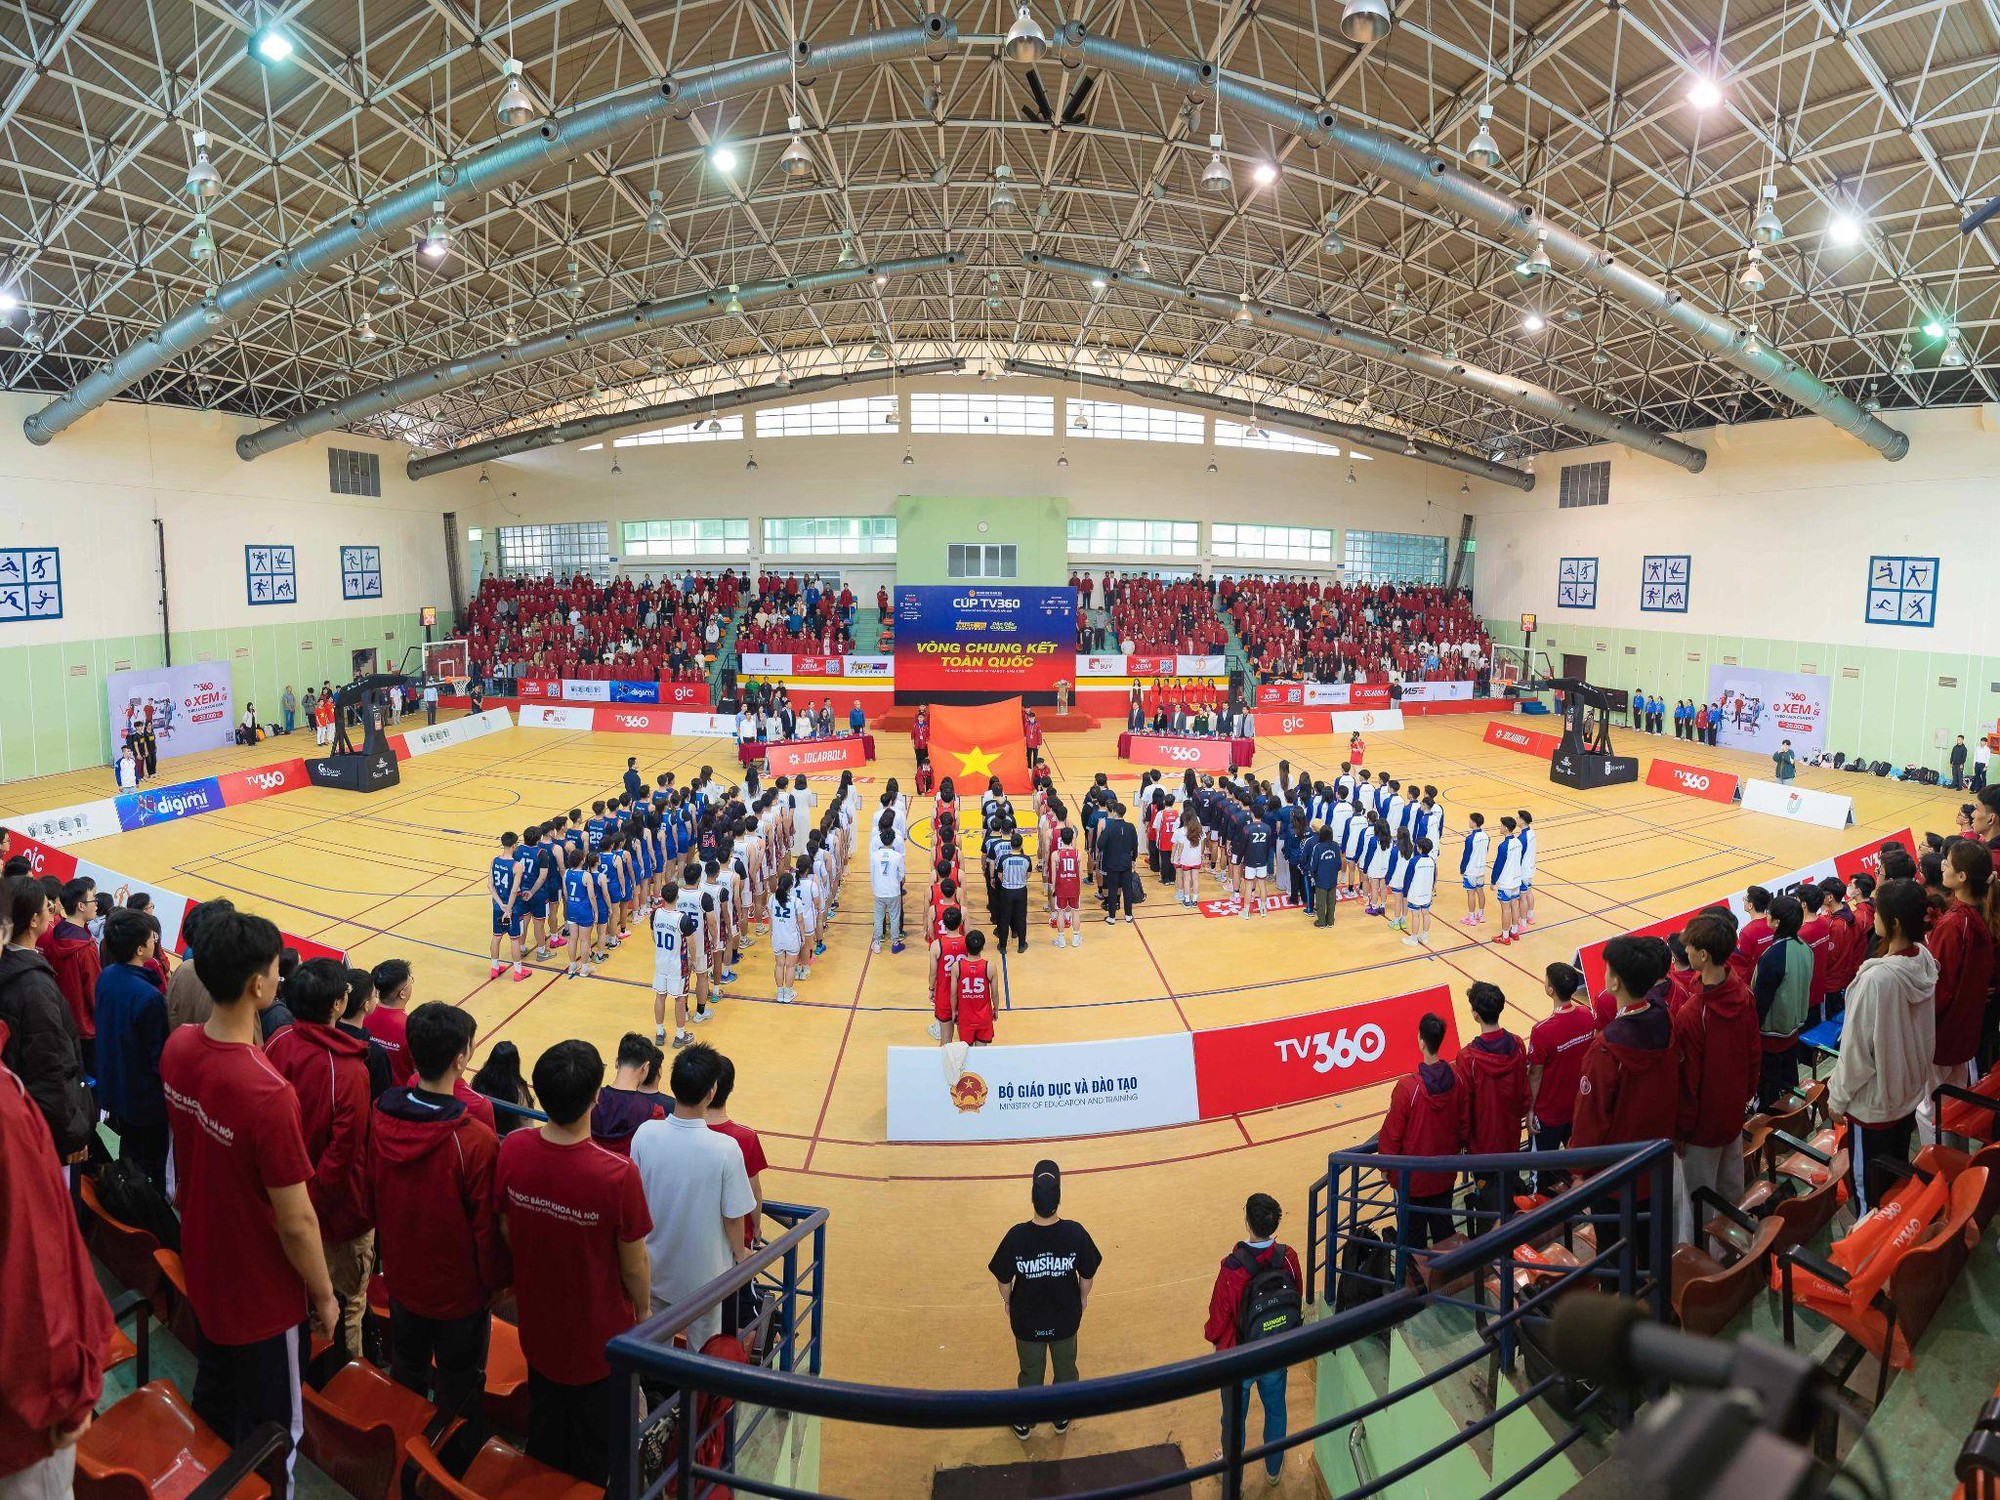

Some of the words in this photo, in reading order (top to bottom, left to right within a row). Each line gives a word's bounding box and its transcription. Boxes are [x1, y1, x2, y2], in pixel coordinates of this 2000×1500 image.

[953, 597, 978, 608] CÚP
[980, 599, 1020, 608] TV360
[917, 641, 960, 653] VÒNG
[965, 643, 1022, 654] CHUNG
[1026, 641, 1058, 654] KẾT
[941, 655, 984, 667] TOÀN
[988, 655, 1034, 668] QUỐC
[193, 691, 220, 706] XEM
[674, 686, 694, 700] gic
[1785, 691, 1806, 701] TV360
[1782, 703, 1811, 715] XEM
[616, 714, 649, 728] TV360
[1283, 716, 1304, 733] gic
[802, 749, 847, 764] JOGARBOLA
[1159, 745, 1201, 761] TV360
[246, 770, 285, 789] TV360
[1673, 769, 1710, 791] TV360
[157, 788, 208, 816] digimi
[702, 834, 717, 848] 54
[1252, 833, 1267, 843] 22
[881, 861, 890, 875] 7
[1062, 858, 1075, 871] 10
[1861, 849, 1884, 876] TV3
[493, 871, 509, 888] 34
[570, 882, 577, 896] 7
[774, 906, 791, 918] 12
[656, 931, 675, 951] 10
[962, 977, 985, 993] 15
[1274, 1023, 1386, 1073] TV360
[999, 1081, 1014, 1101] BỘ
[1018, 1080, 1045, 1098] GIÁO
[1048, 1082, 1071, 1099] DỤC
[1074, 1077, 1088, 1094] VÀ
[1092, 1075, 1114, 1093] ĐÀO
[1117, 1076, 1138, 1093] TẠO
[1000, 1101, 1031, 1110] MINISTRY
[1032, 1101, 1043, 1109] OF
[1044, 1098, 1086, 1108] EDUCATION
[1087, 1096, 1105, 1105] AND
[1105, 1093, 1138, 1103] TRAINING
[530, 1197, 551, 1208] BÁCH
[551, 1202, 571, 1215] KHOA
[572, 1209, 582, 1219] HÀ
[584, 1212, 600, 1221] NỘI
[1872, 1202, 1902, 1221] TV360
[1893, 1218, 1921, 1248] TV360
[1016, 1256, 1076, 1274] GYMSHARK
[1025, 1270, 1051, 1279] TRAINING
